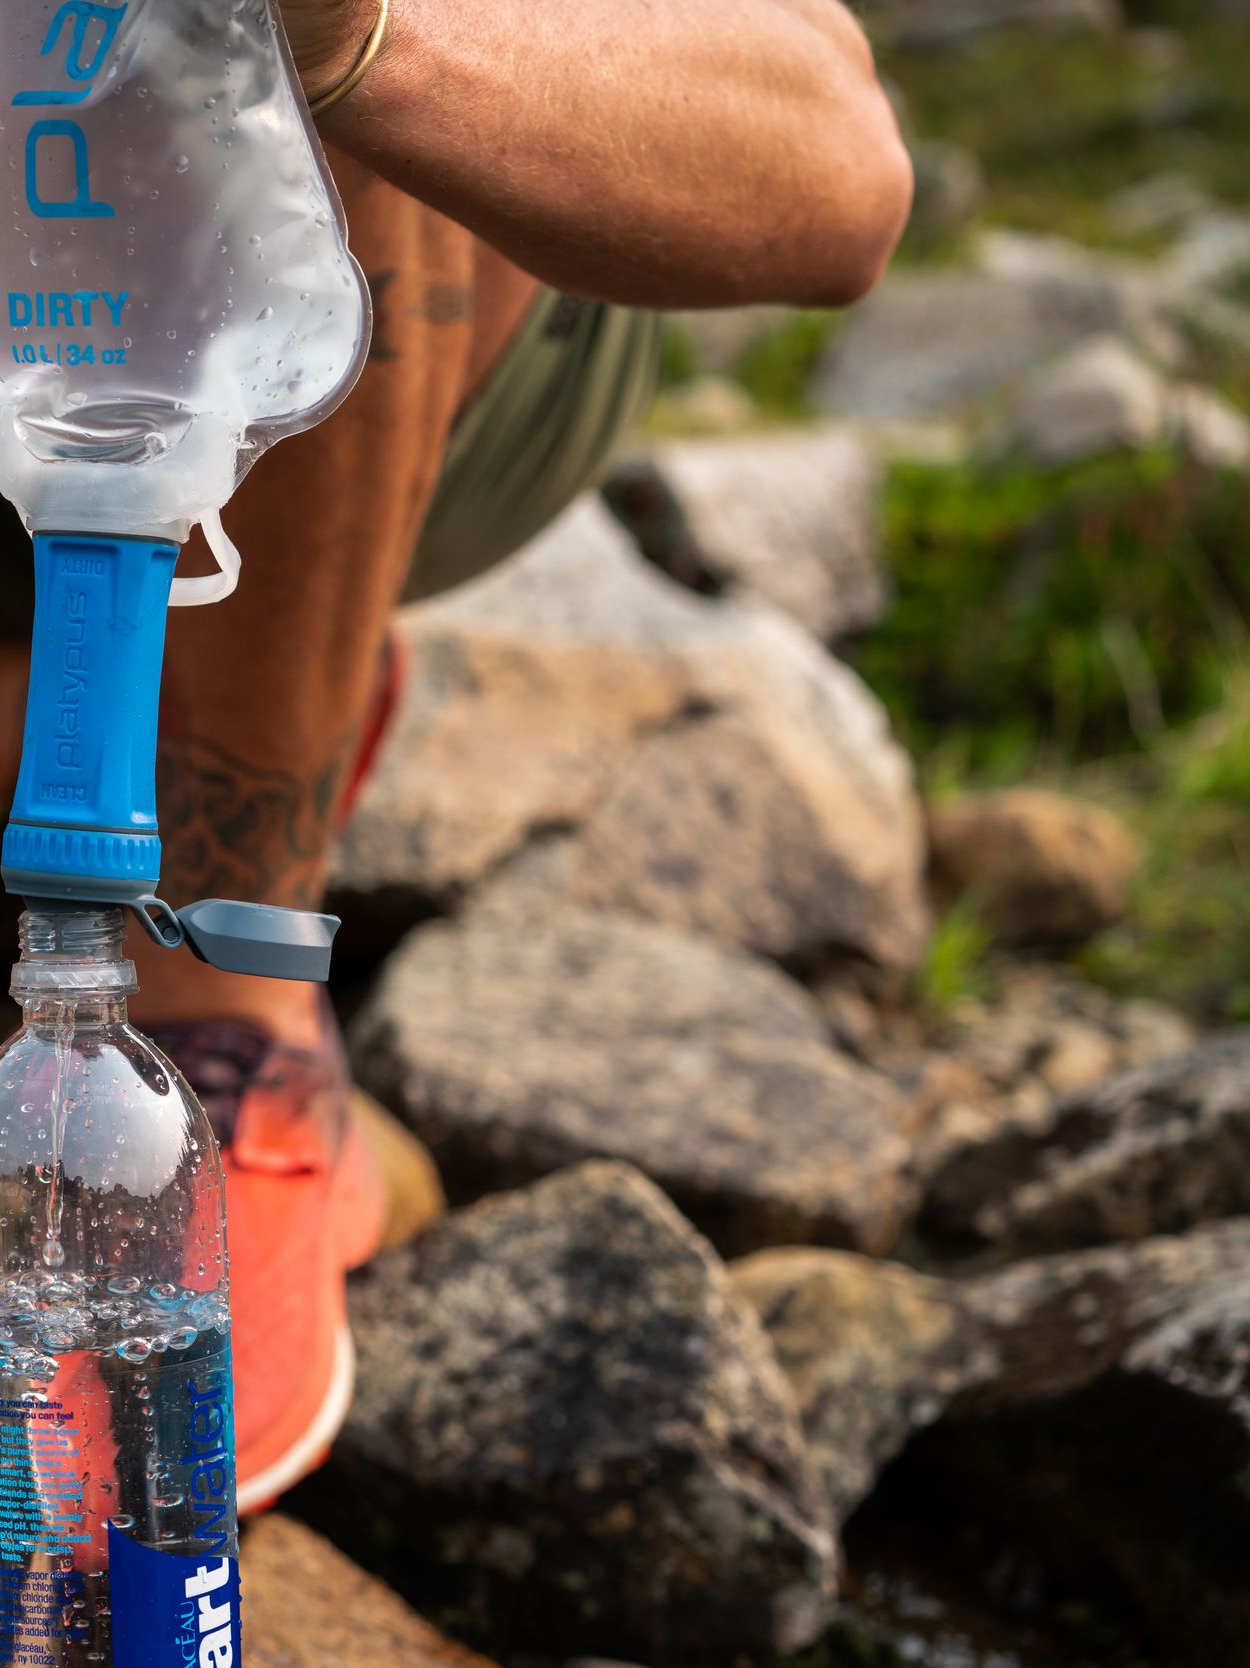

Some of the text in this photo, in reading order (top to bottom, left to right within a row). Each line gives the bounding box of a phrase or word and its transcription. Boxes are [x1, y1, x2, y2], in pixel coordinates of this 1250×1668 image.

[7, 290, 129, 327] DIRTY
[66, 342, 96, 365] 34
[101, 348, 127, 365] oz
[61, 558, 105, 576] DIRTY
[56, 590, 88, 770] platypus
[40, 783, 86, 802] CLEAN
[7, 1399, 21, 1408] you
[21, 1410, 36, 1420] you
[38, 1412, 54, 1420] can
[57, 1412, 74, 1420] feel
[1, 1424, 24, 1435] might
[2, 1434, 14, 1444] but
[16, 1436, 34, 1446] they
[7, 1446, 34, 1457] purest
[0, 1468, 26, 1478] smart,
[18, 1479, 38, 1489] from
[0, 1487, 27, 1498] friends
[28, 1490, 45, 1499] and
[0, 1499, 59, 1510] vapor-distilled
[25, 1512, 44, 1521] with
[14, 1521, 28, 1530] pH.
[30, 1523, 50, 1531] then
[14, 1532, 40, 1542] nature
[43, 1533, 60, 1542] and
[26, 1543, 37, 1553] for
[47, 1544, 74, 1555] crisp,
[1, 1551, 24, 1562] taste.
[22, 1594, 54, 1604] chloride
[25, 1628, 49, 1637] added
[14, 1641, 46, 1655] glacéau,
[18, 1655, 26, 1664] ny
[29, 1655, 55, 1665] 10022
